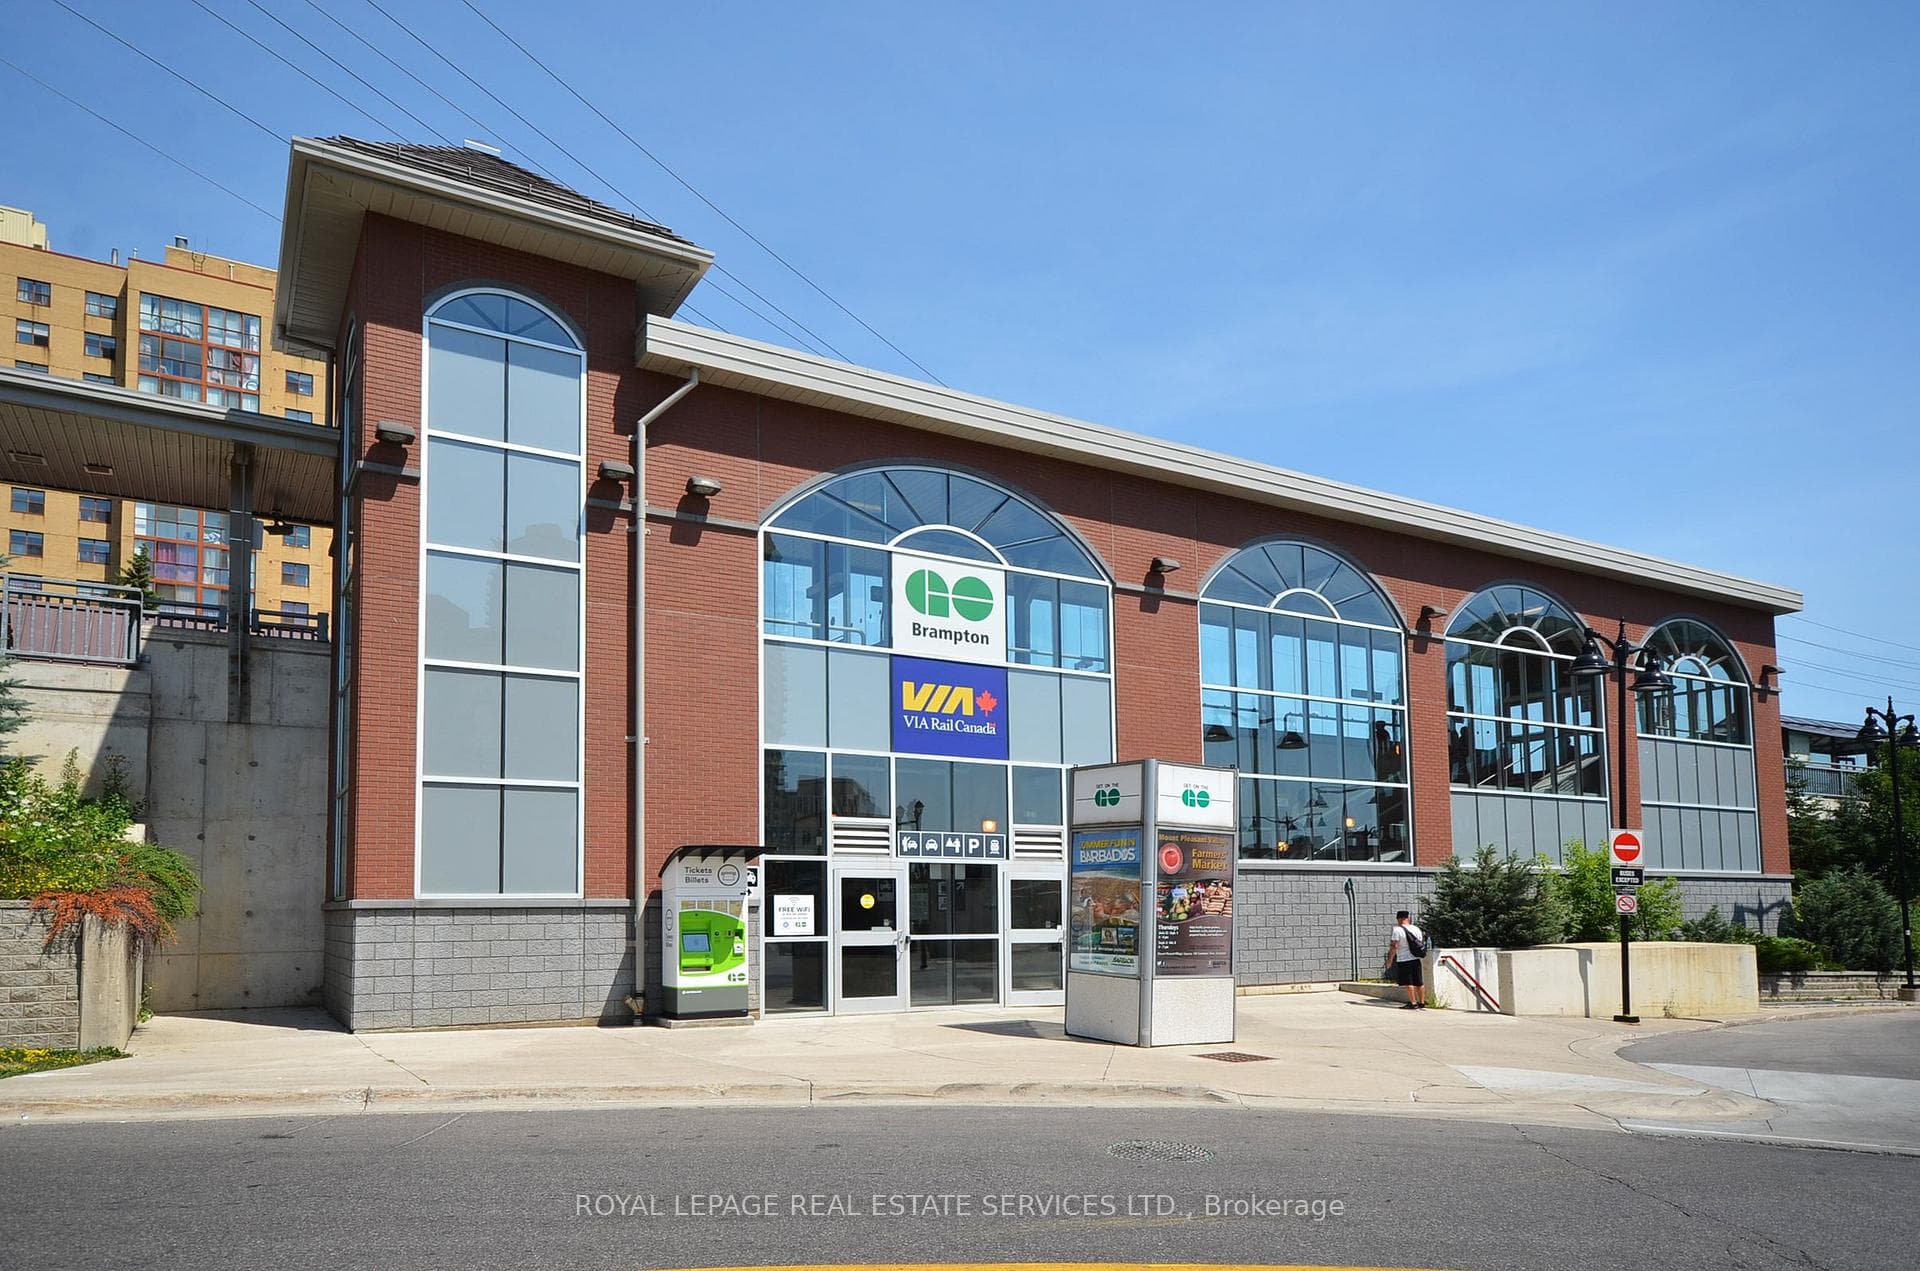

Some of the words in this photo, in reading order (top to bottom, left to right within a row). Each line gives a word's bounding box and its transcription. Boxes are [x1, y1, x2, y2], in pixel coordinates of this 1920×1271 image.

[905, 569, 994, 622] GO
[912, 621, 989, 645] Brampton
[902, 681, 974, 716] VIA
[903, 715, 929, 730] VIA
[931, 717, 954, 732] Rail
[955, 719, 997, 735] Canada
[1158, 833, 1179, 842] Mount
[1080, 848, 1137, 864] BARBADOS
[684, 866, 713, 874] Tickets
[1192, 859, 1228, 871] Market
[684, 876, 709, 884] Billets
